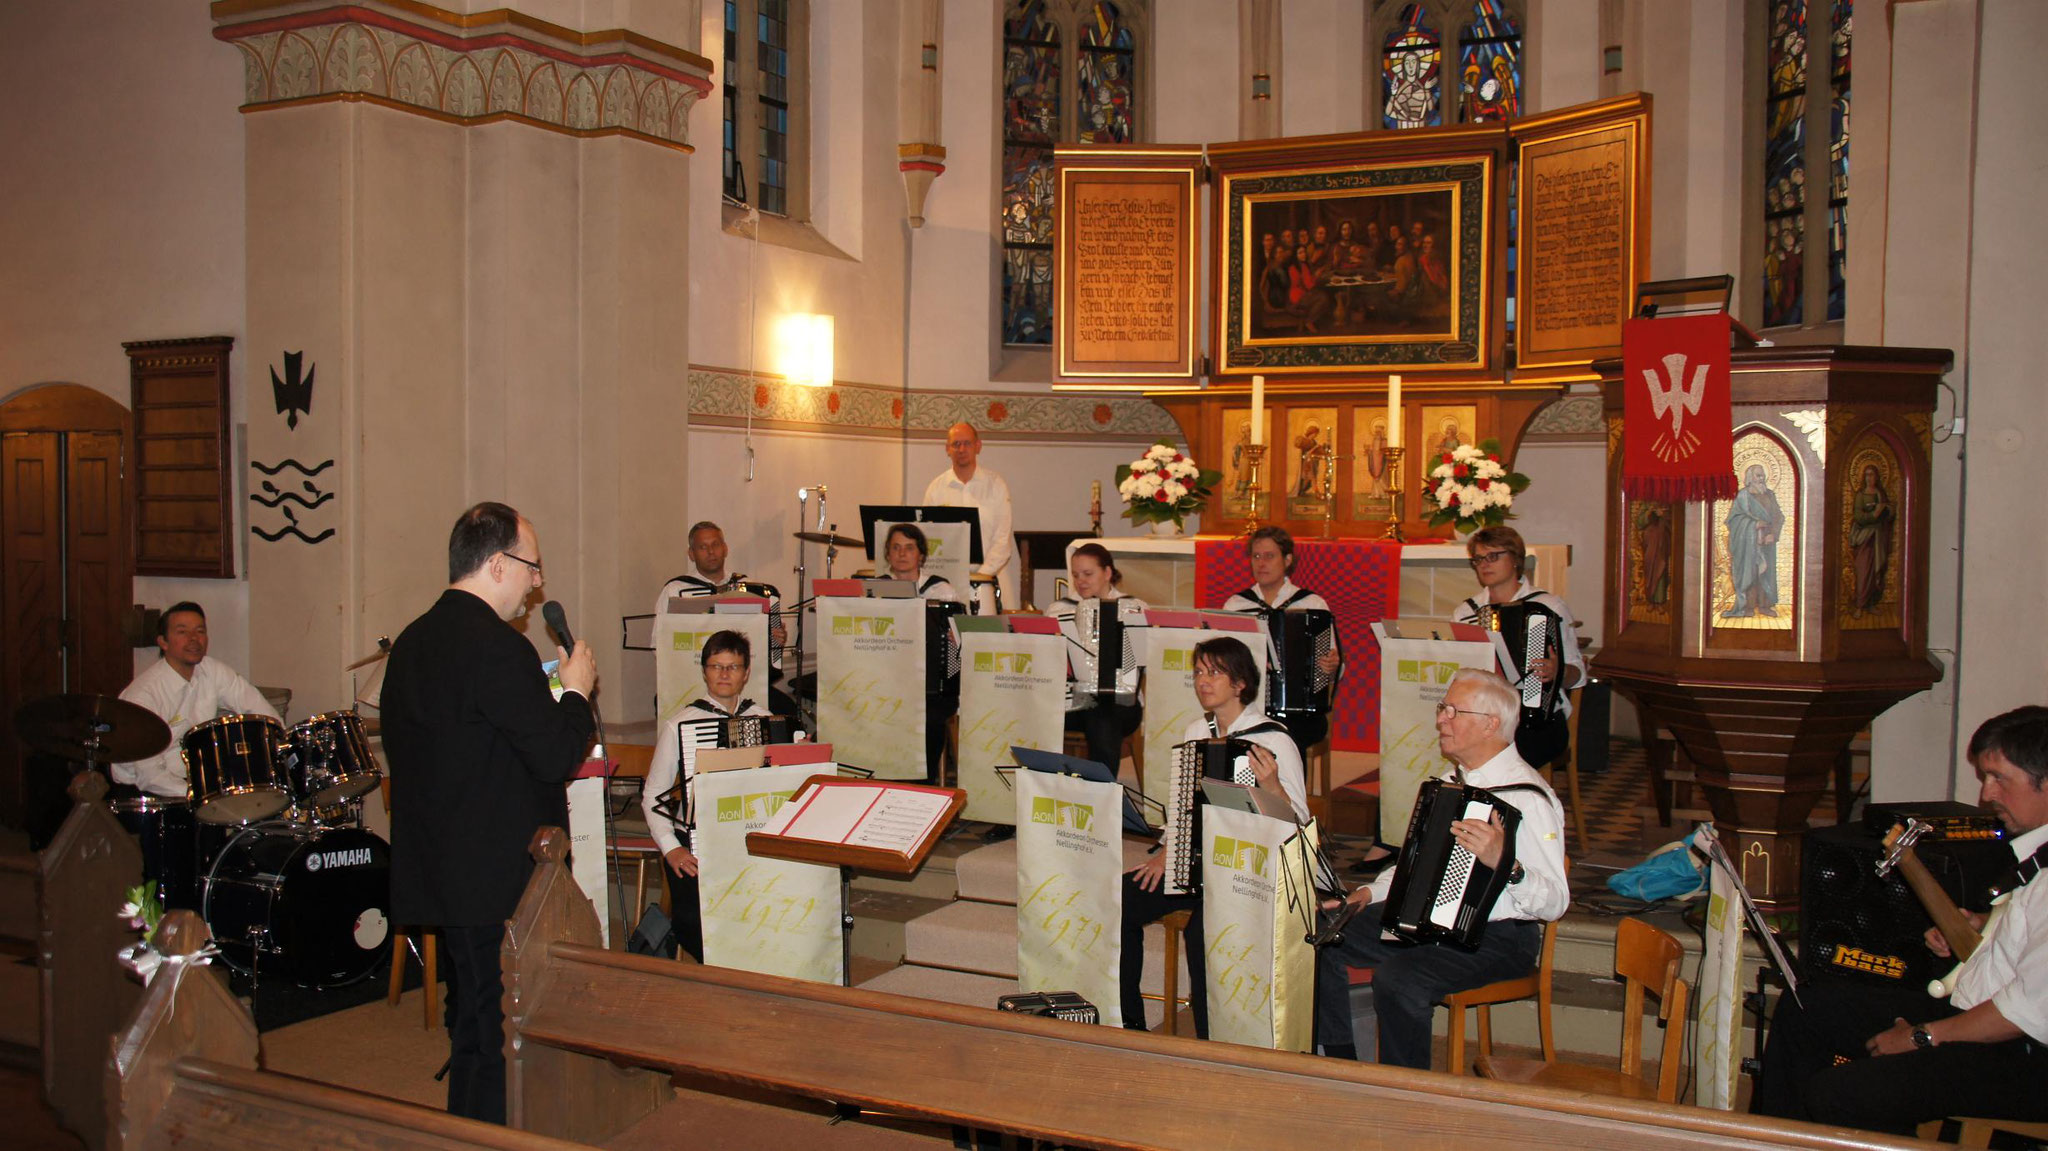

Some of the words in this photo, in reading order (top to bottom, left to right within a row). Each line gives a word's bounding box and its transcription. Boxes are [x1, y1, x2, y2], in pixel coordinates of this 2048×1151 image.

[719, 810, 741, 821] AON
[1033, 811, 1054, 823] AON
[745, 822, 767, 830] Akkor
[323, 848, 372, 869] YAMAHA
[1214, 852, 1232, 866] AON
[1835, 945, 1905, 969] Mark
[1843, 956, 1902, 977] bass
